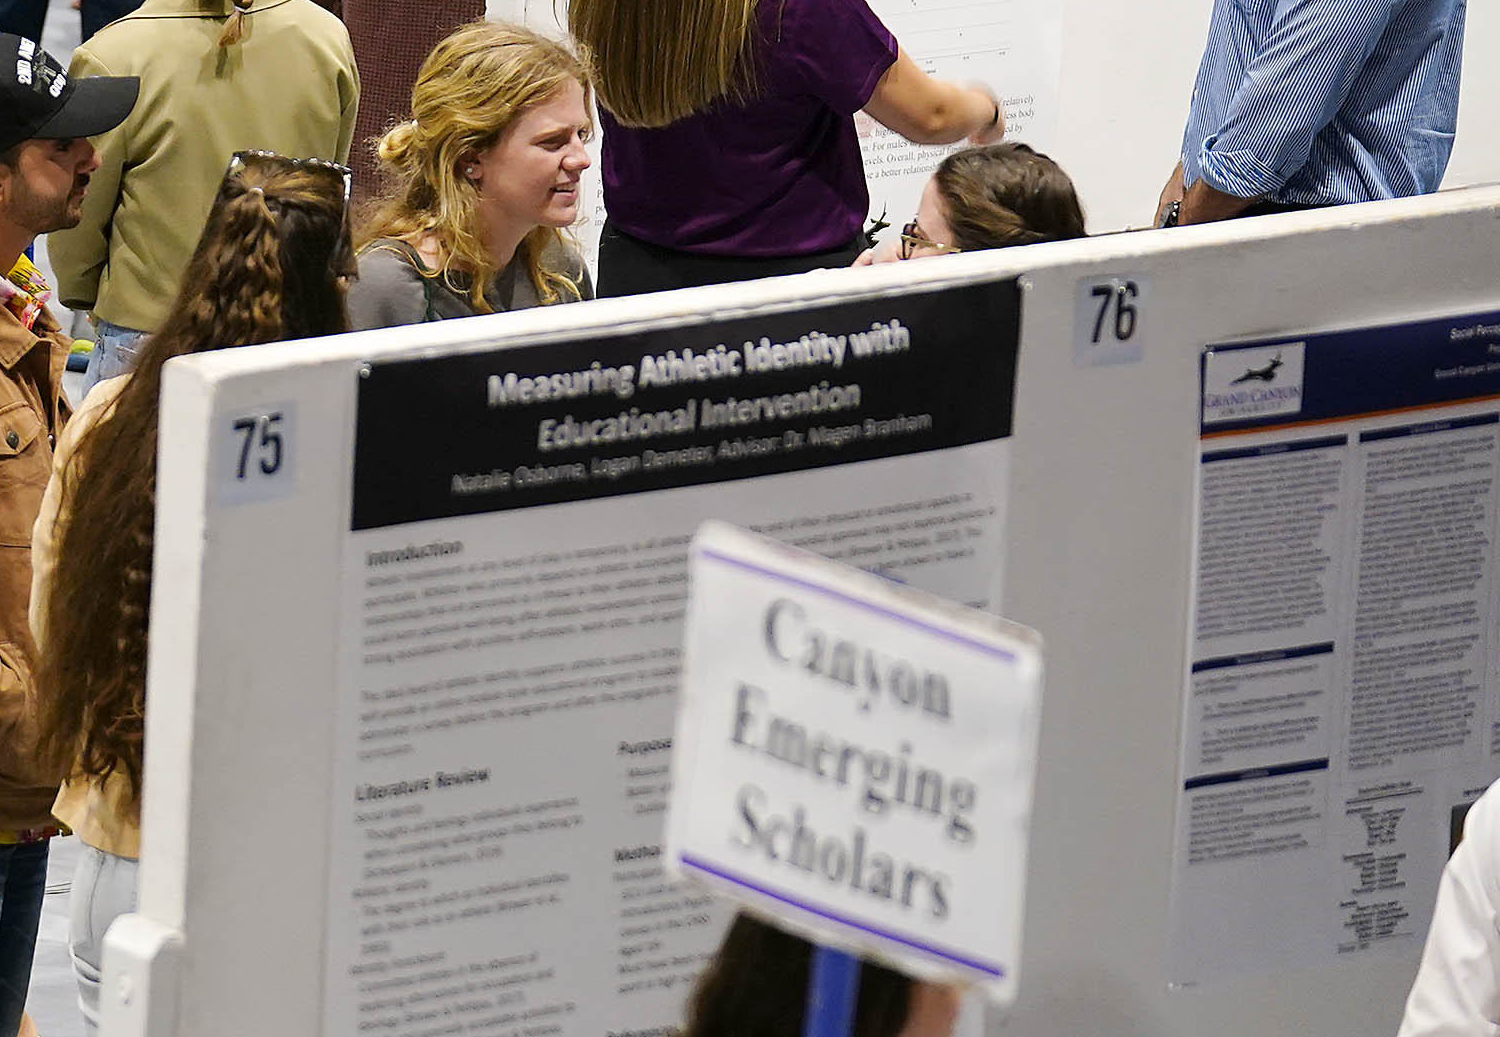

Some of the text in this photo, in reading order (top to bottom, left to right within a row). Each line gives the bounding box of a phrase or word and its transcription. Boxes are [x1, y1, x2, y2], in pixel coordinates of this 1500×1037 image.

[1003, 95, 1034, 106] relatively
[1019, 108, 1035, 118] body
[881, 168, 901, 177] better
[886, 149, 945, 162] Overall, physical
[1090, 284, 1138, 343] 76
[487, 319, 911, 410] Measuring Athletic Identity with
[538, 380, 861, 452] Educational Intervention
[232, 413, 285, 481] 75
[366, 541, 463, 566] Introduction
[764, 598, 952, 718] Canyon
[354, 768, 490, 801] Literature Review
[731, 682, 980, 844] Emerging
[730, 788, 950, 924] Scholars
